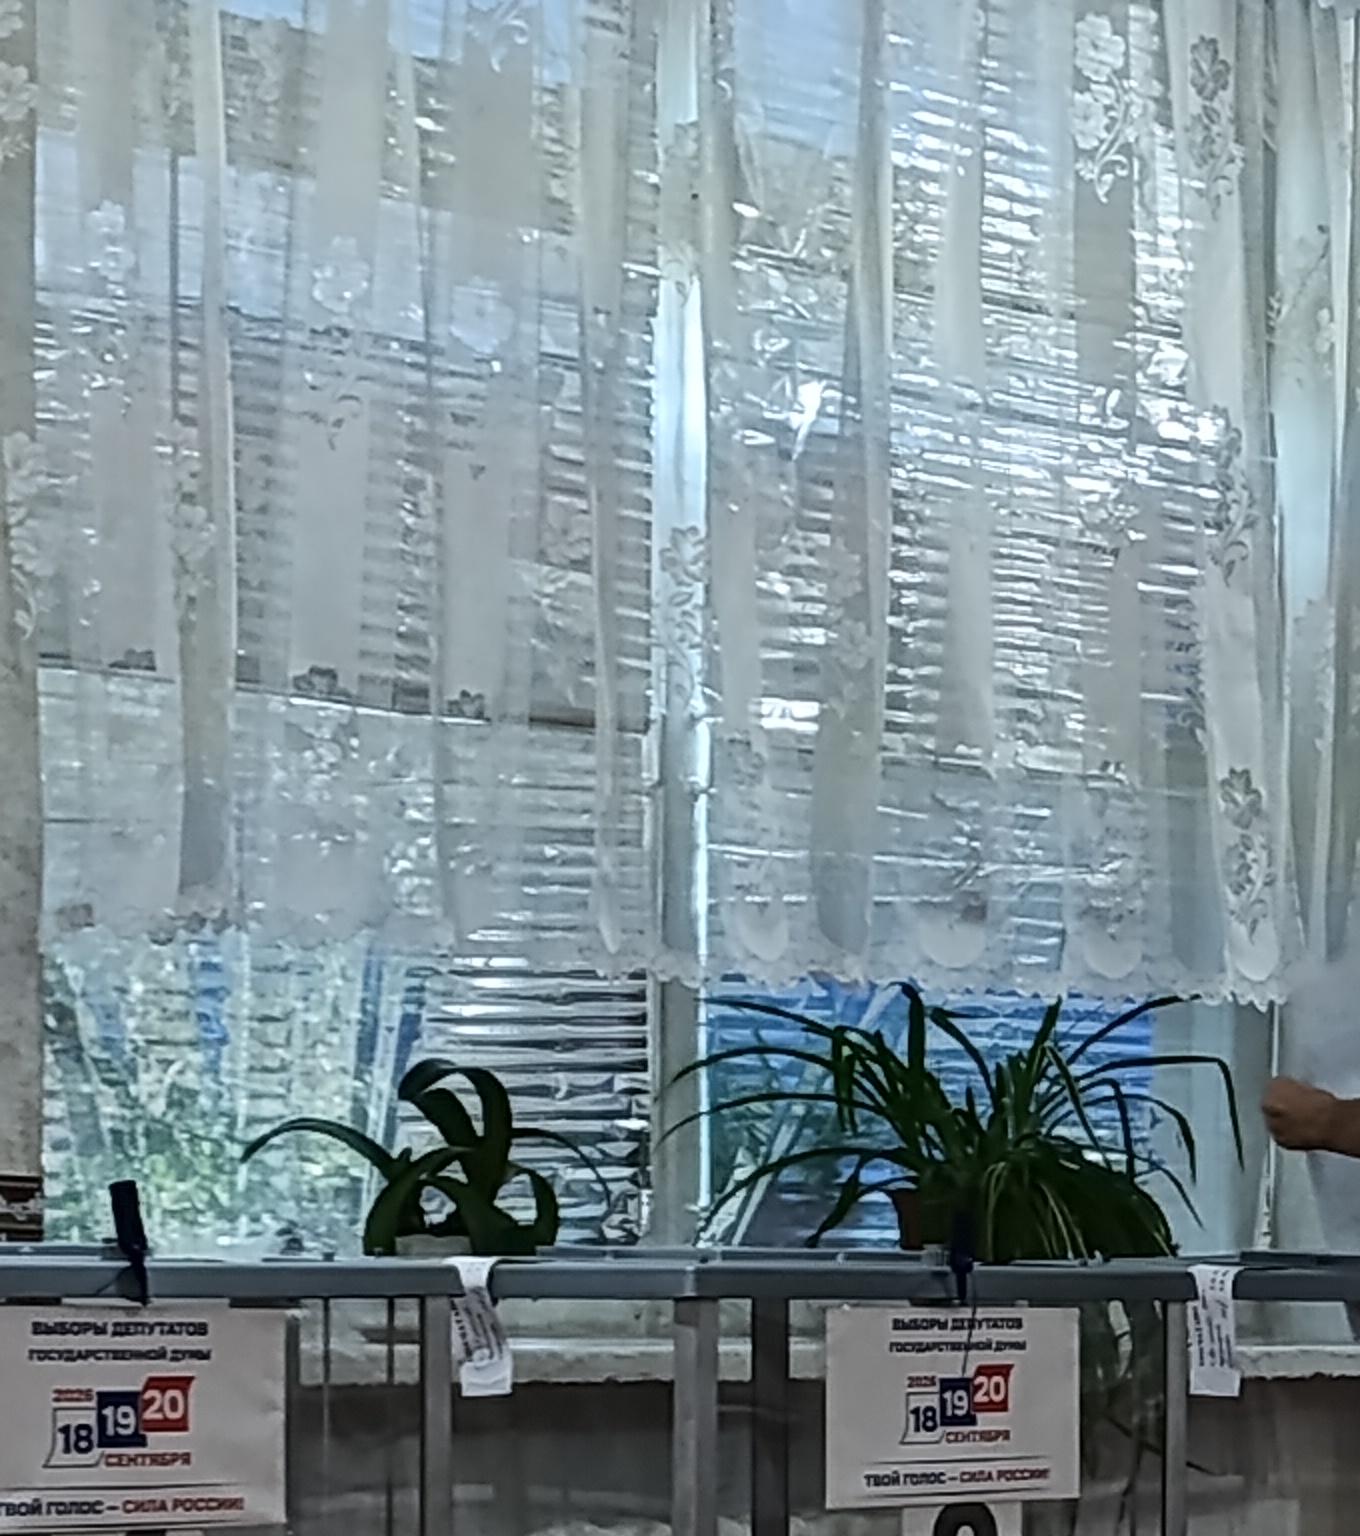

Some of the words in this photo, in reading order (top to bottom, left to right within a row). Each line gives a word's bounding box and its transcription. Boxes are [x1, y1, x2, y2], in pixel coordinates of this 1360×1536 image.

[32, 1321, 108, 1335] ВЫБОРЫ
[111, 1321, 208, 1337] ДЕПУТАТОВ
[892, 1318, 948, 1330] ВЫБОРЫ
[950, 1318, 1022, 1331] ДЕПУТАТОВ
[910, 1405, 938, 1432] 18
[942, 1390, 969, 1416] 19
[973, 1376, 1006, 1402] 20
[58, 1423, 94, 1454] 18
[102, 1405, 136, 1436] 19
[142, 1389, 185, 1420] 20
[945, 1430, 1010, 1443] СЕНТЯБРЯ
[104, 1452, 191, 1467] СЕНТЯБРЯ
[864, 1470, 900, 1487] ТВОЙ
[903, 1471, 946, 1485] ГОЛОС
[959, 1470, 993, 1483] СИЛА
[46, 1500, 104, 1516] ГОЛОС
[122, 1500, 168, 1514] СИЛА
